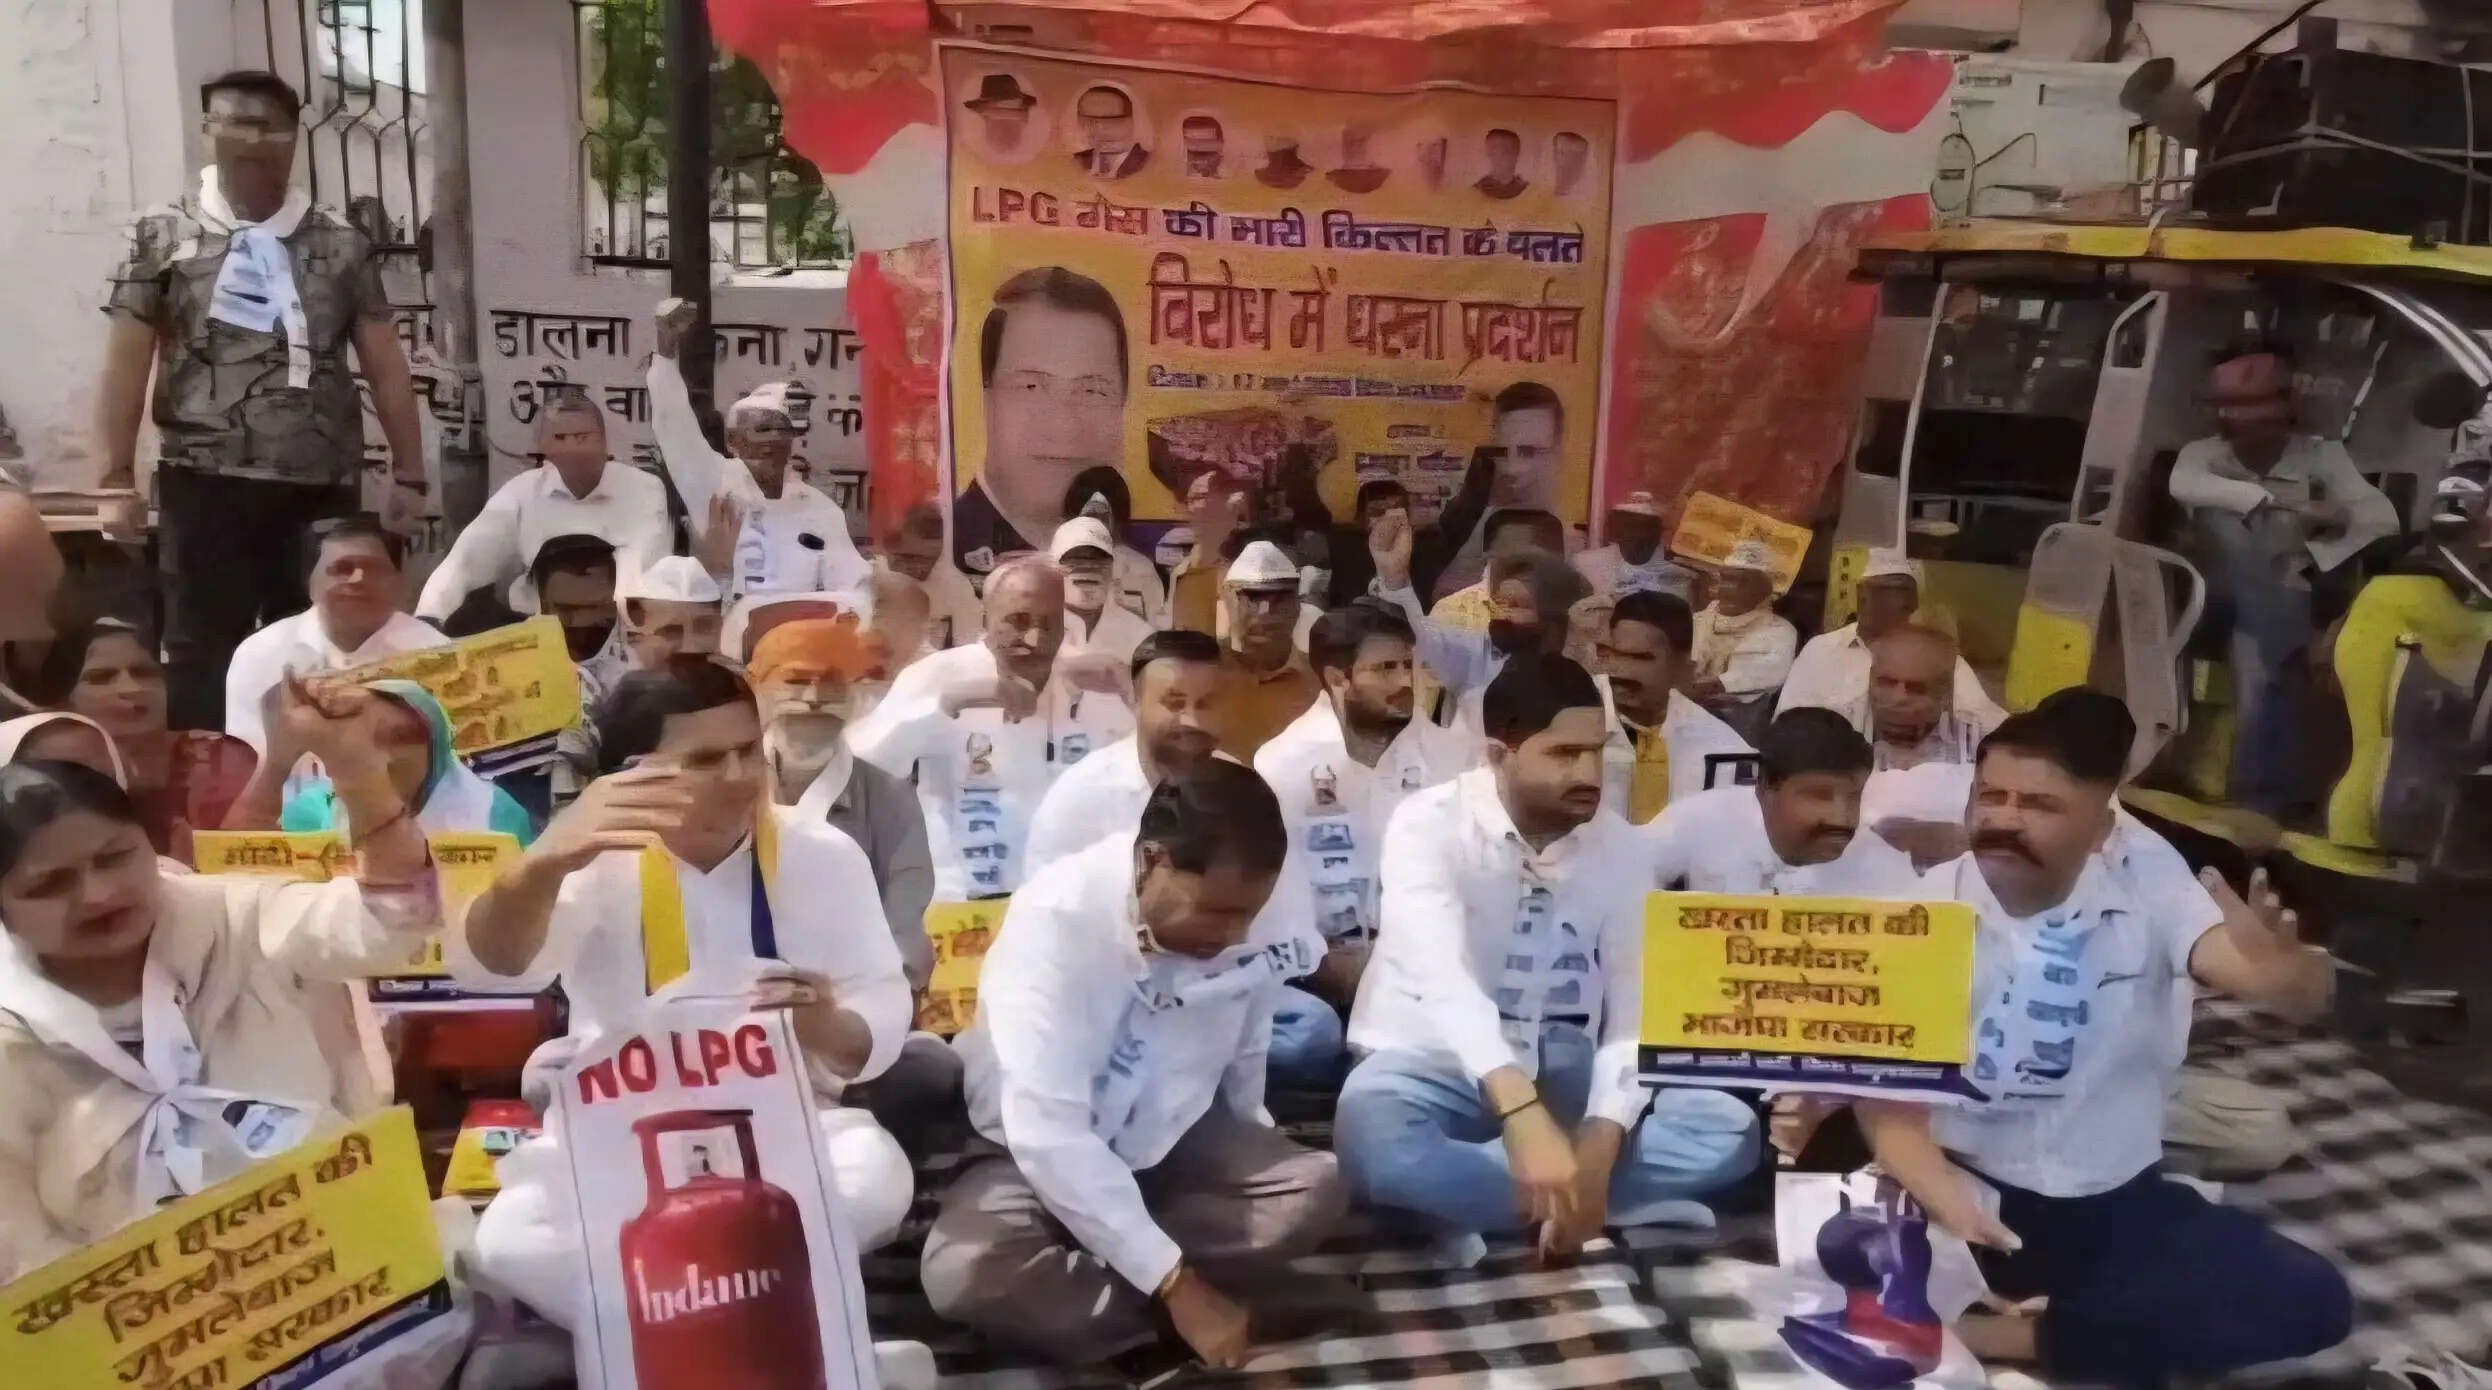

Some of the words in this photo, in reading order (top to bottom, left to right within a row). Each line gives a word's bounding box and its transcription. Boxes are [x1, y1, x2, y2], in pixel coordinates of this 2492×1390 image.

[972, 186, 1060, 226] LPG
[1162, 200, 1218, 241] की
[489, 309, 632, 359] डालना
[1146, 251, 1278, 352] विरोध
[1289, 264, 1339, 353] में
[1346, 293, 1448, 361] धरना
[1455, 276, 1585, 379] प्रदर्शन
[1781, 909, 1873, 936] हालत
[1884, 903, 1929, 936] की
[576, 1034, 659, 1105] NO
[670, 1023, 777, 1088] LPG
[11, 1239, 161, 1335] खस्ता
[175, 1173, 302, 1256] हालत
[313, 1131, 373, 1184] की
[244, 1264, 392, 1362] सरकार
